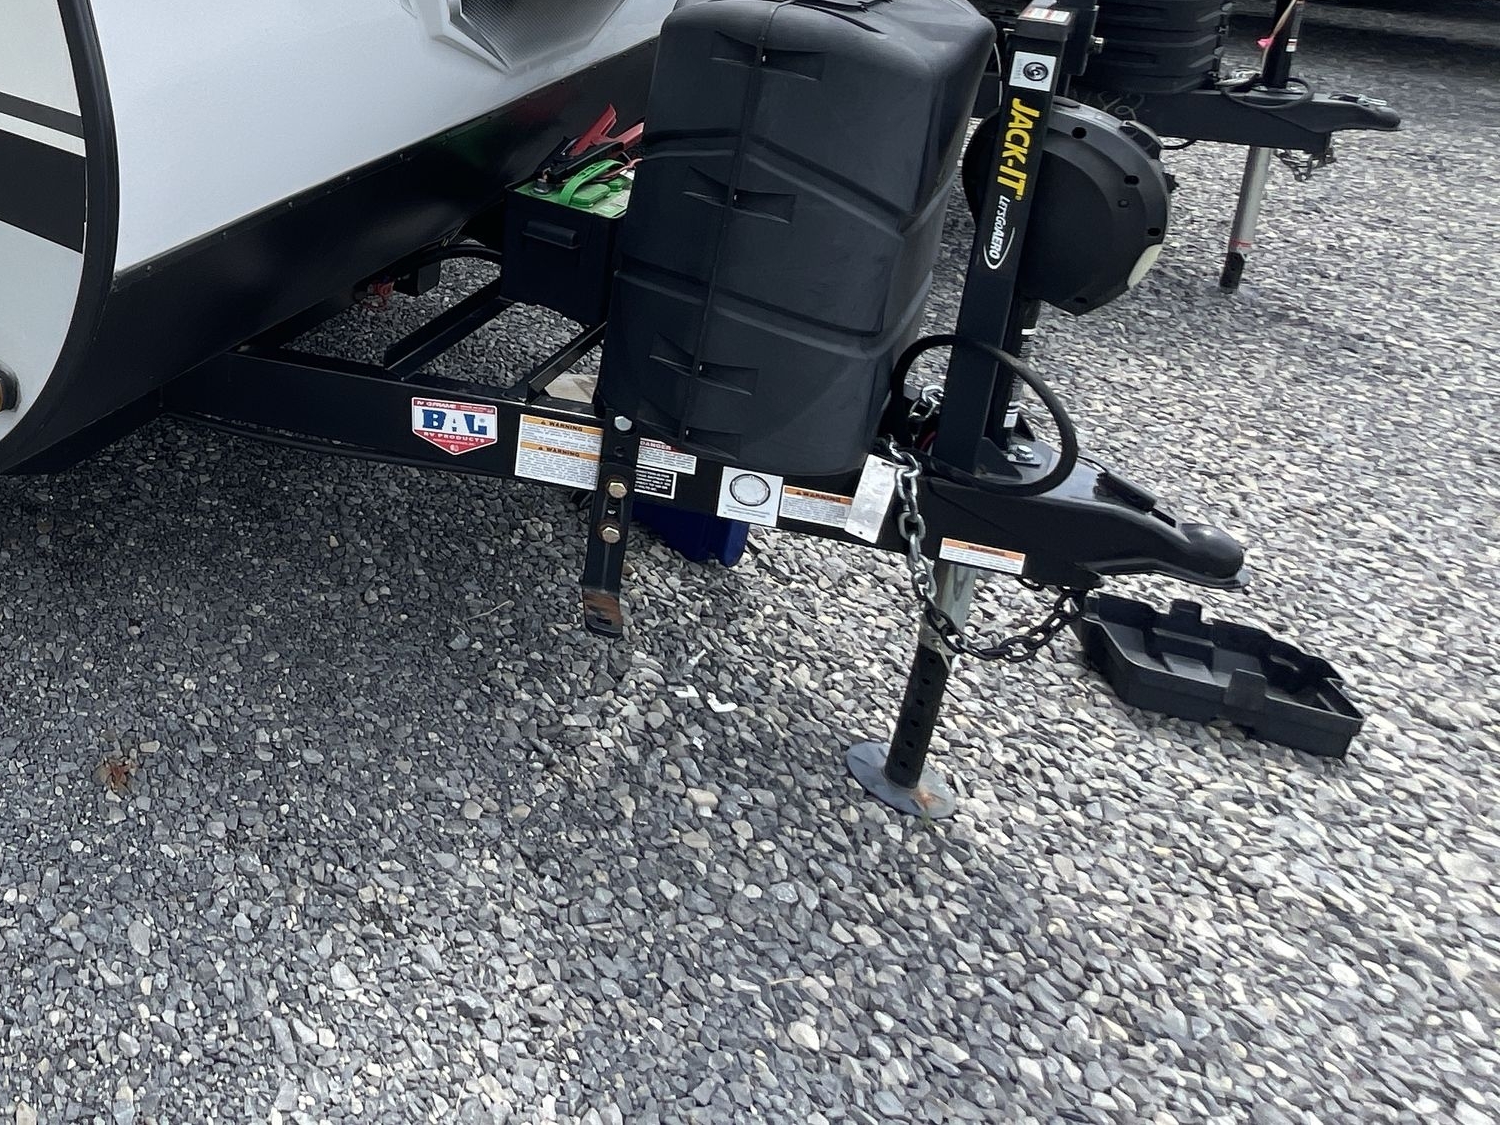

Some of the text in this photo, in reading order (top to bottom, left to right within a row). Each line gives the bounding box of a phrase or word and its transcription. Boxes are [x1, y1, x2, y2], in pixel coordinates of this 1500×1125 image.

[422, 409, 488, 435] BAL
[549, 421, 583, 432] WARNING
[438, 433, 485, 443] PRODUCTS
[640, 440, 672, 451] DANGER
[546, 446, 580, 457] WARNING
